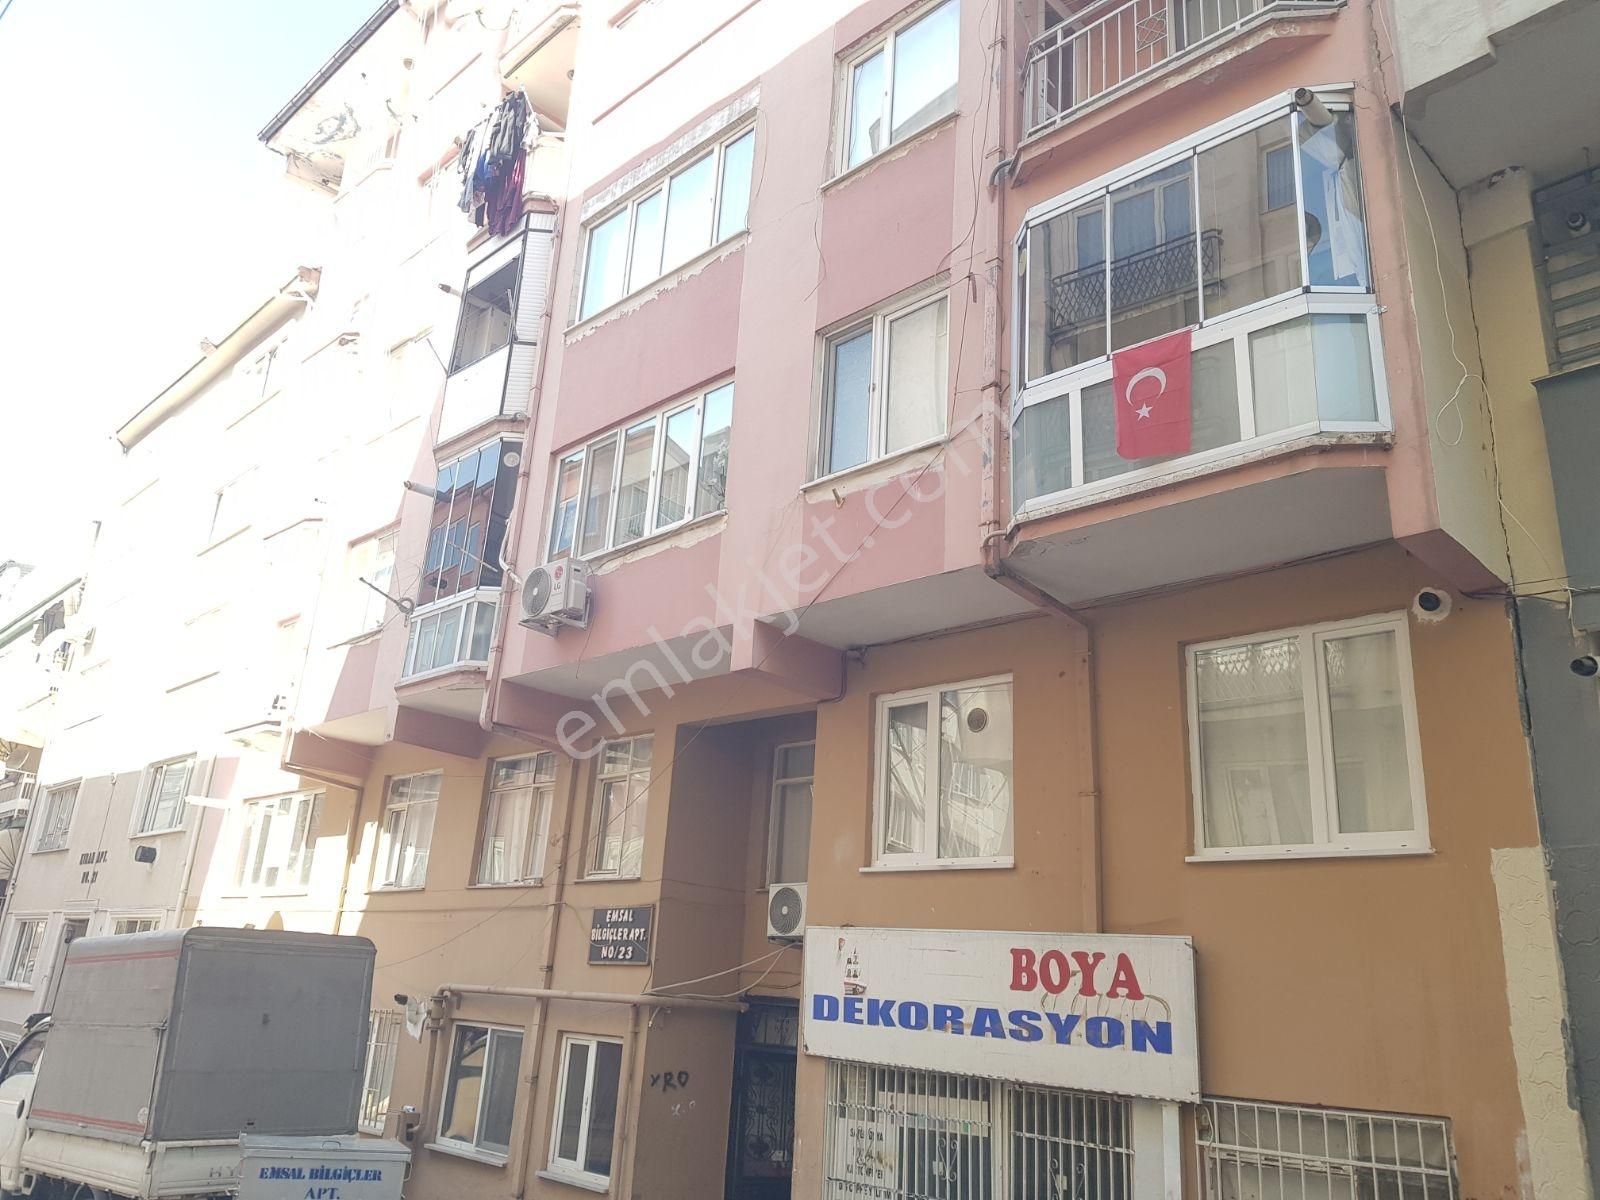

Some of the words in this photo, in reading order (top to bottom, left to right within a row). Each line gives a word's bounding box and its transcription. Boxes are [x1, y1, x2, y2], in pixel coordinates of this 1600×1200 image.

[553, 582, 562, 591] LG
[606, 909, 634, 922] EMSAL
[591, 923, 628, 944] BİLGİÇLER
[628, 928, 647, 941] APT.
[601, 945, 634, 959] NO/23
[1009, 948, 1145, 1000] BOYA
[812, 994, 1173, 1055] DEKORASYON
[259, 1166, 305, 1180] EMSAL
[308, 1165, 382, 1183] BİLGİÇLER
[304, 1187, 340, 1200] APT.
